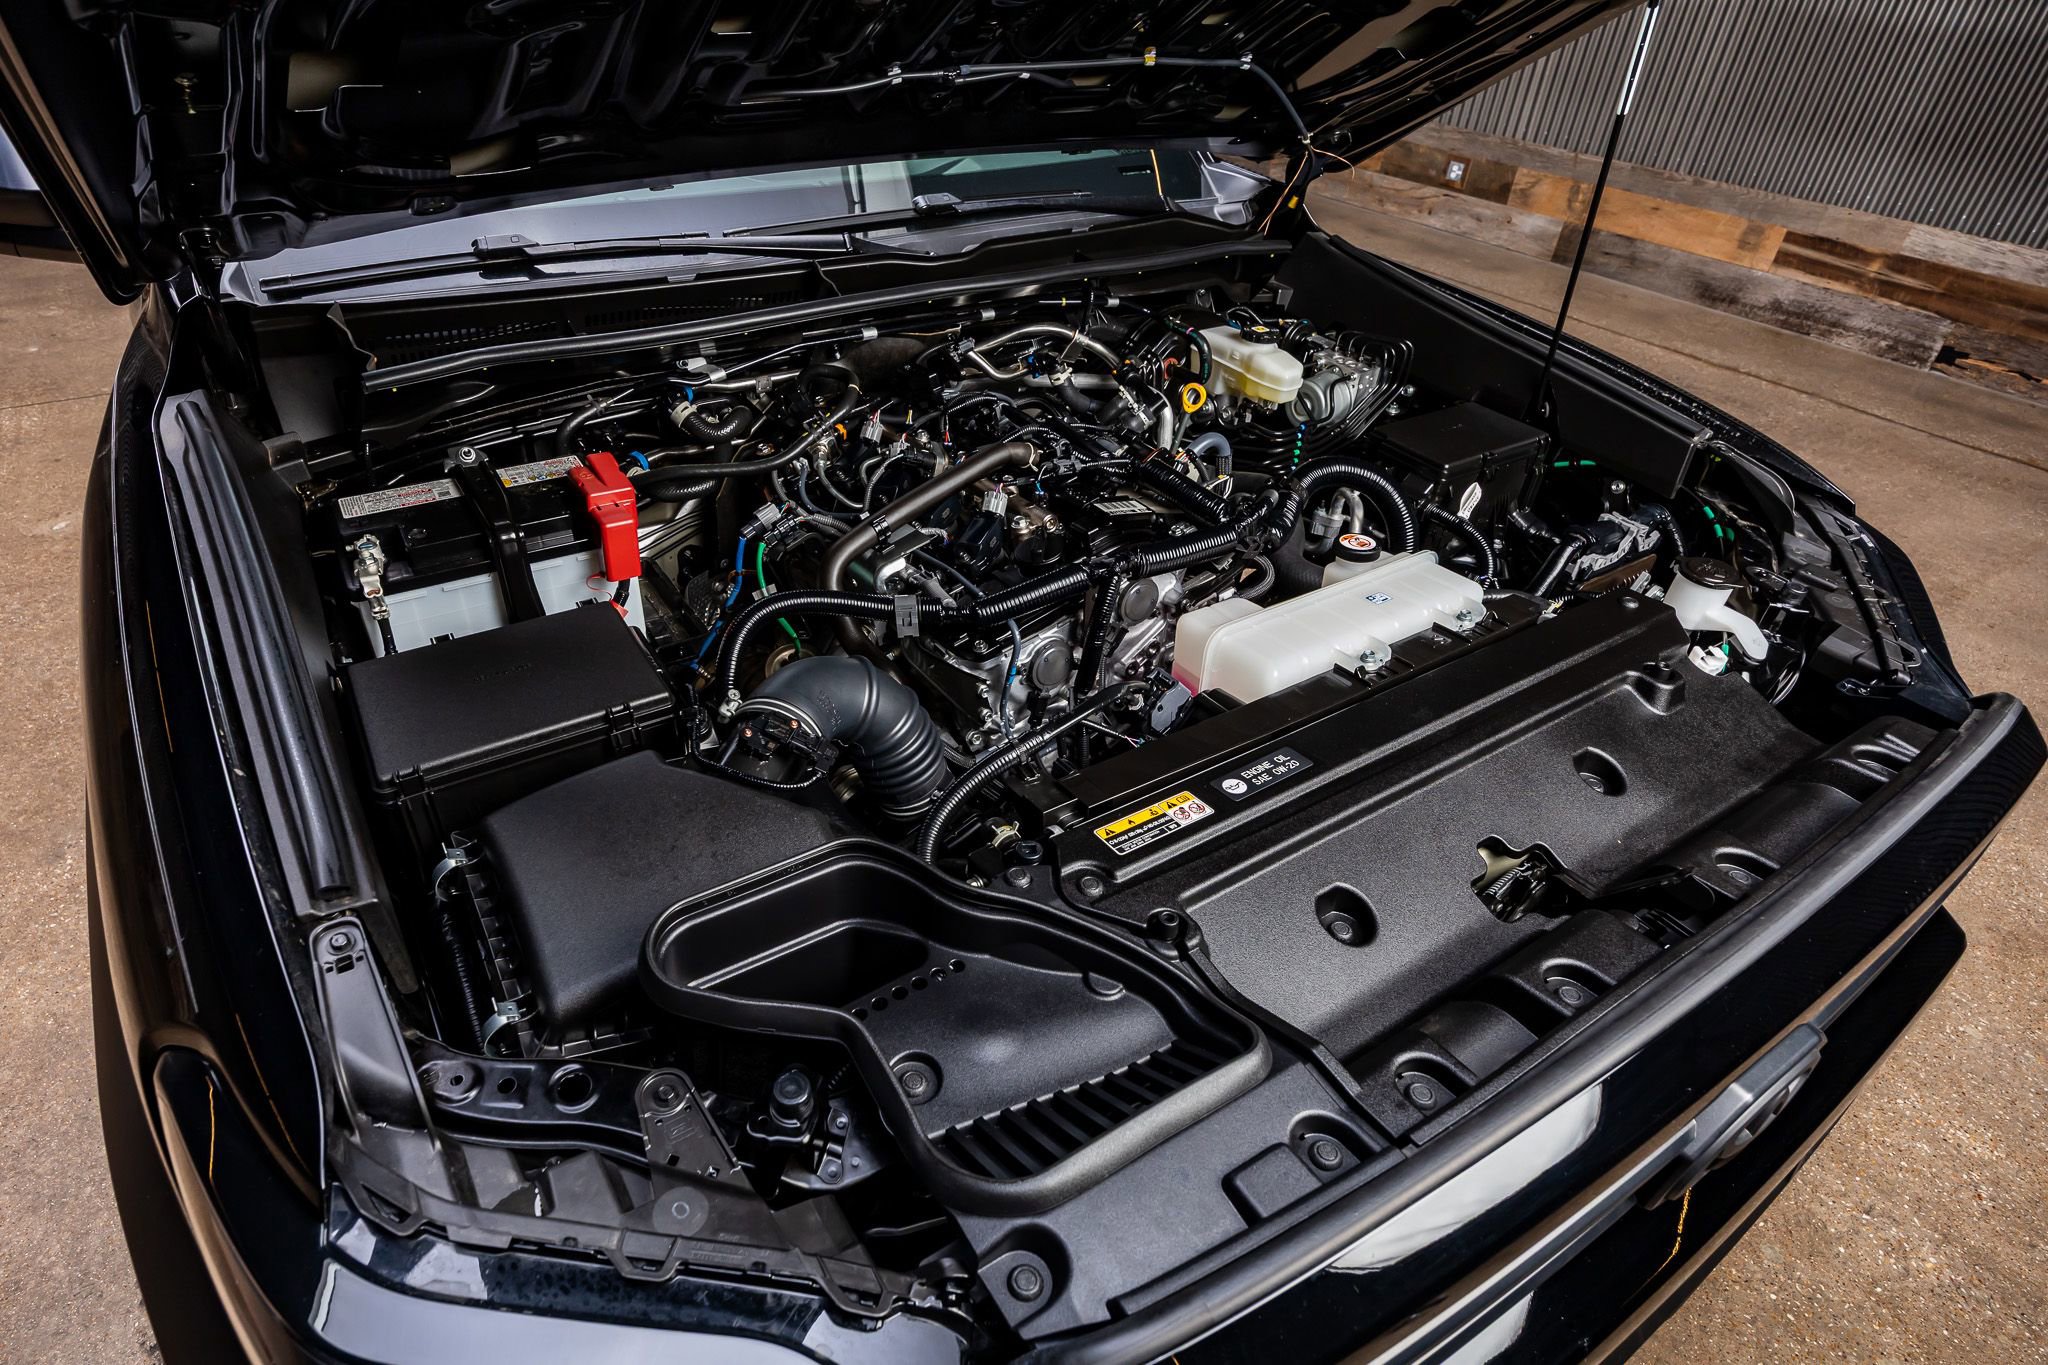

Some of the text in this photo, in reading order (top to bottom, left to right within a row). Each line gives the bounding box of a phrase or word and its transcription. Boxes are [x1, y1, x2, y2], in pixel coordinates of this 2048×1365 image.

[1241, 754, 1290, 779] ENGINE OIL
[1252, 760, 1300, 785] SAE 0W-20
